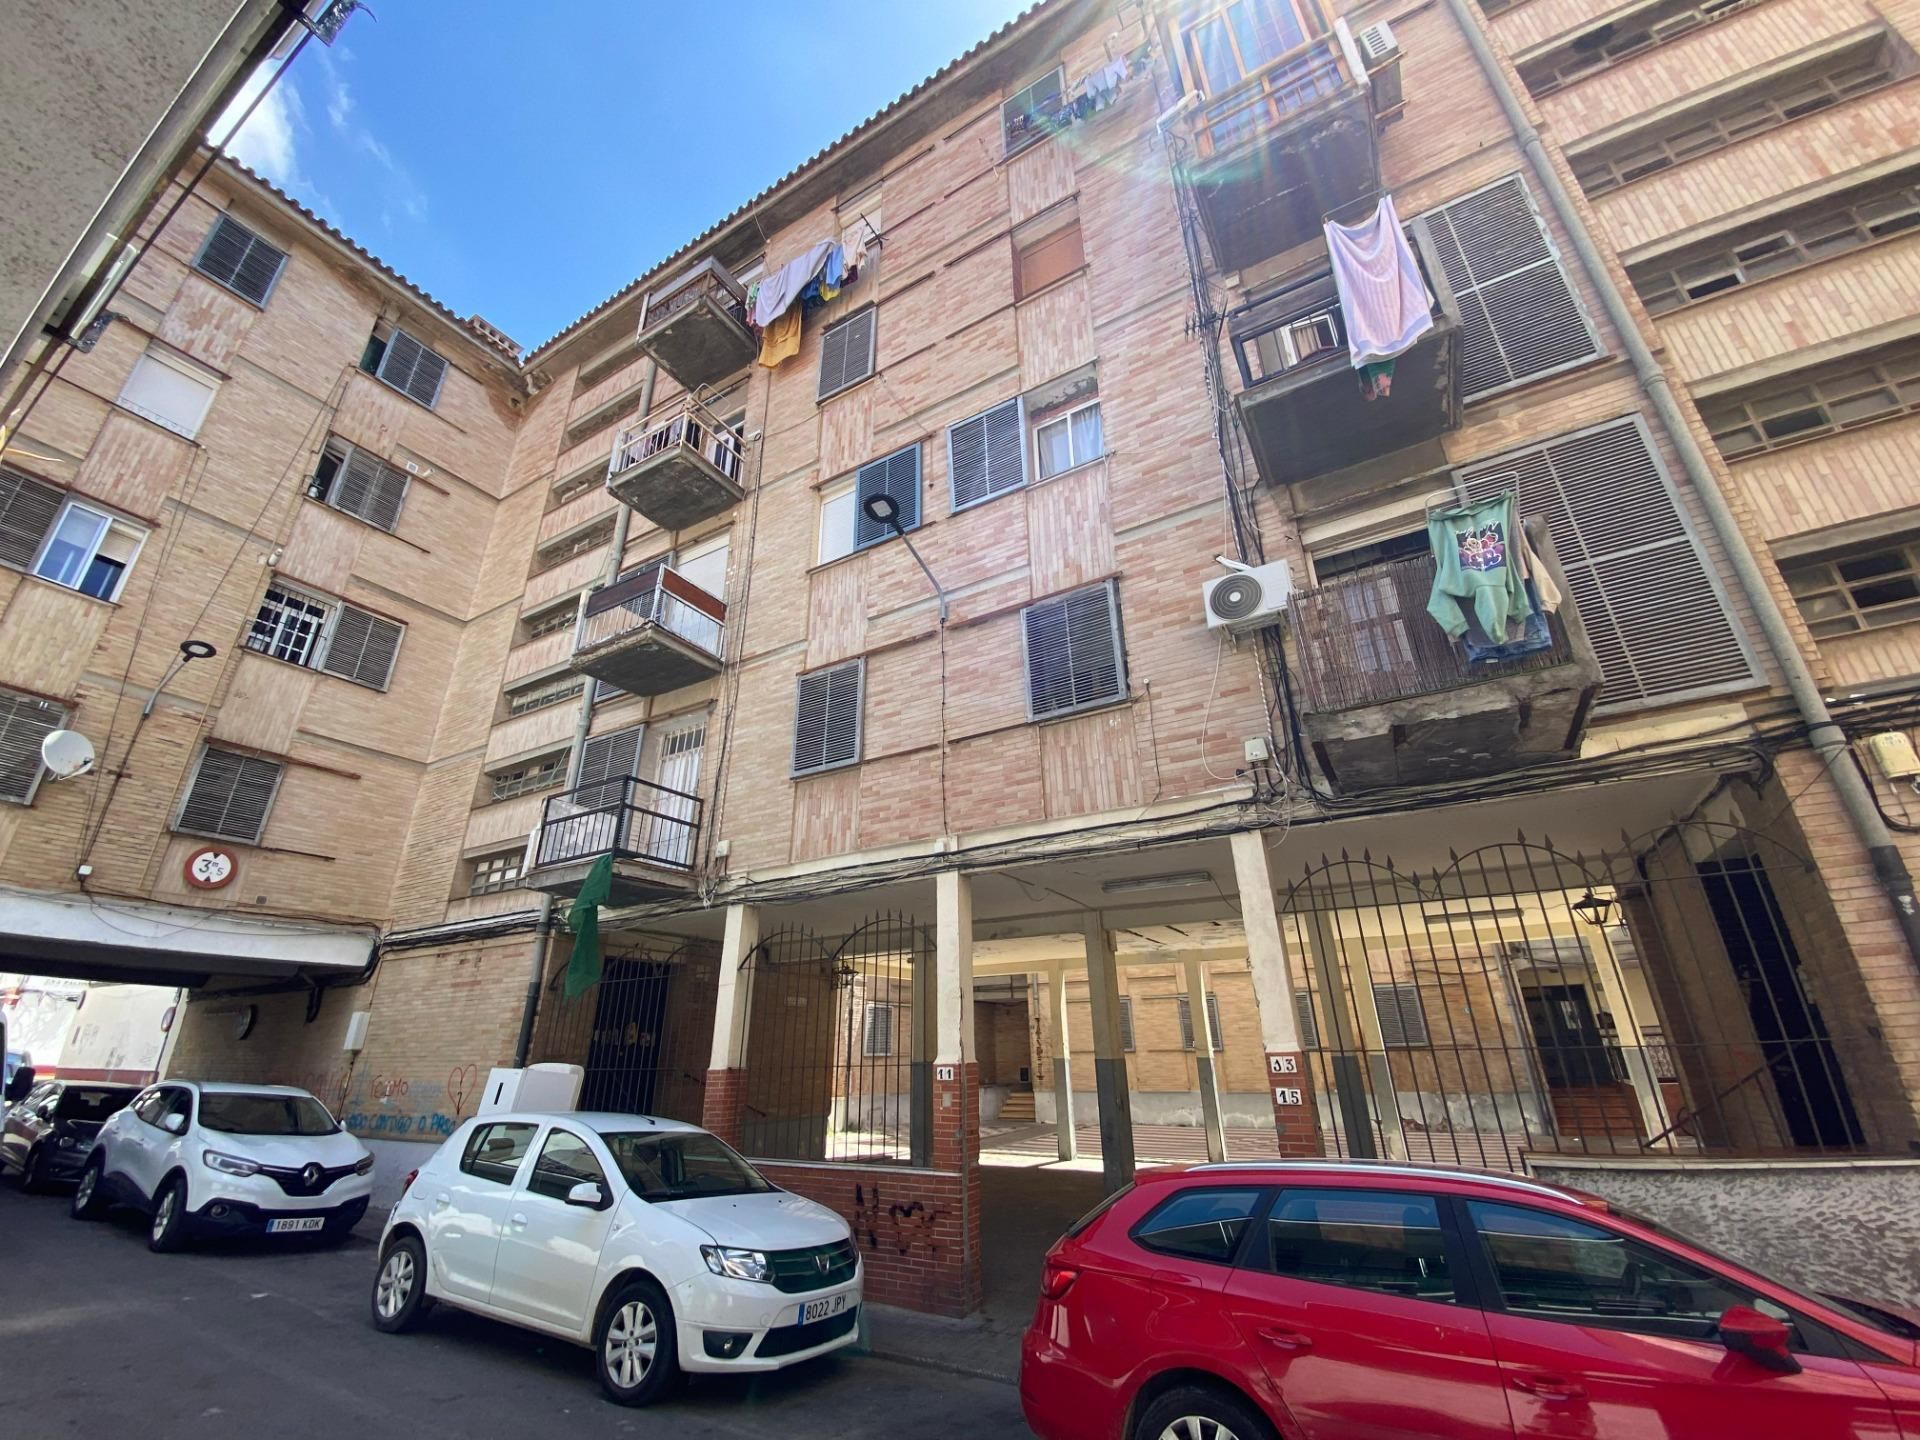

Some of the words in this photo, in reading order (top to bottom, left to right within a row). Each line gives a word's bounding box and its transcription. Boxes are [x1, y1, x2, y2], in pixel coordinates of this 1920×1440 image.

[938, 1068, 952, 1079] 11
[1279, 1090, 1299, 1104] 15
[276, 1219, 300, 1230] 1891
[805, 1300, 830, 1321] 8022
[831, 1294, 847, 1313] JPY
